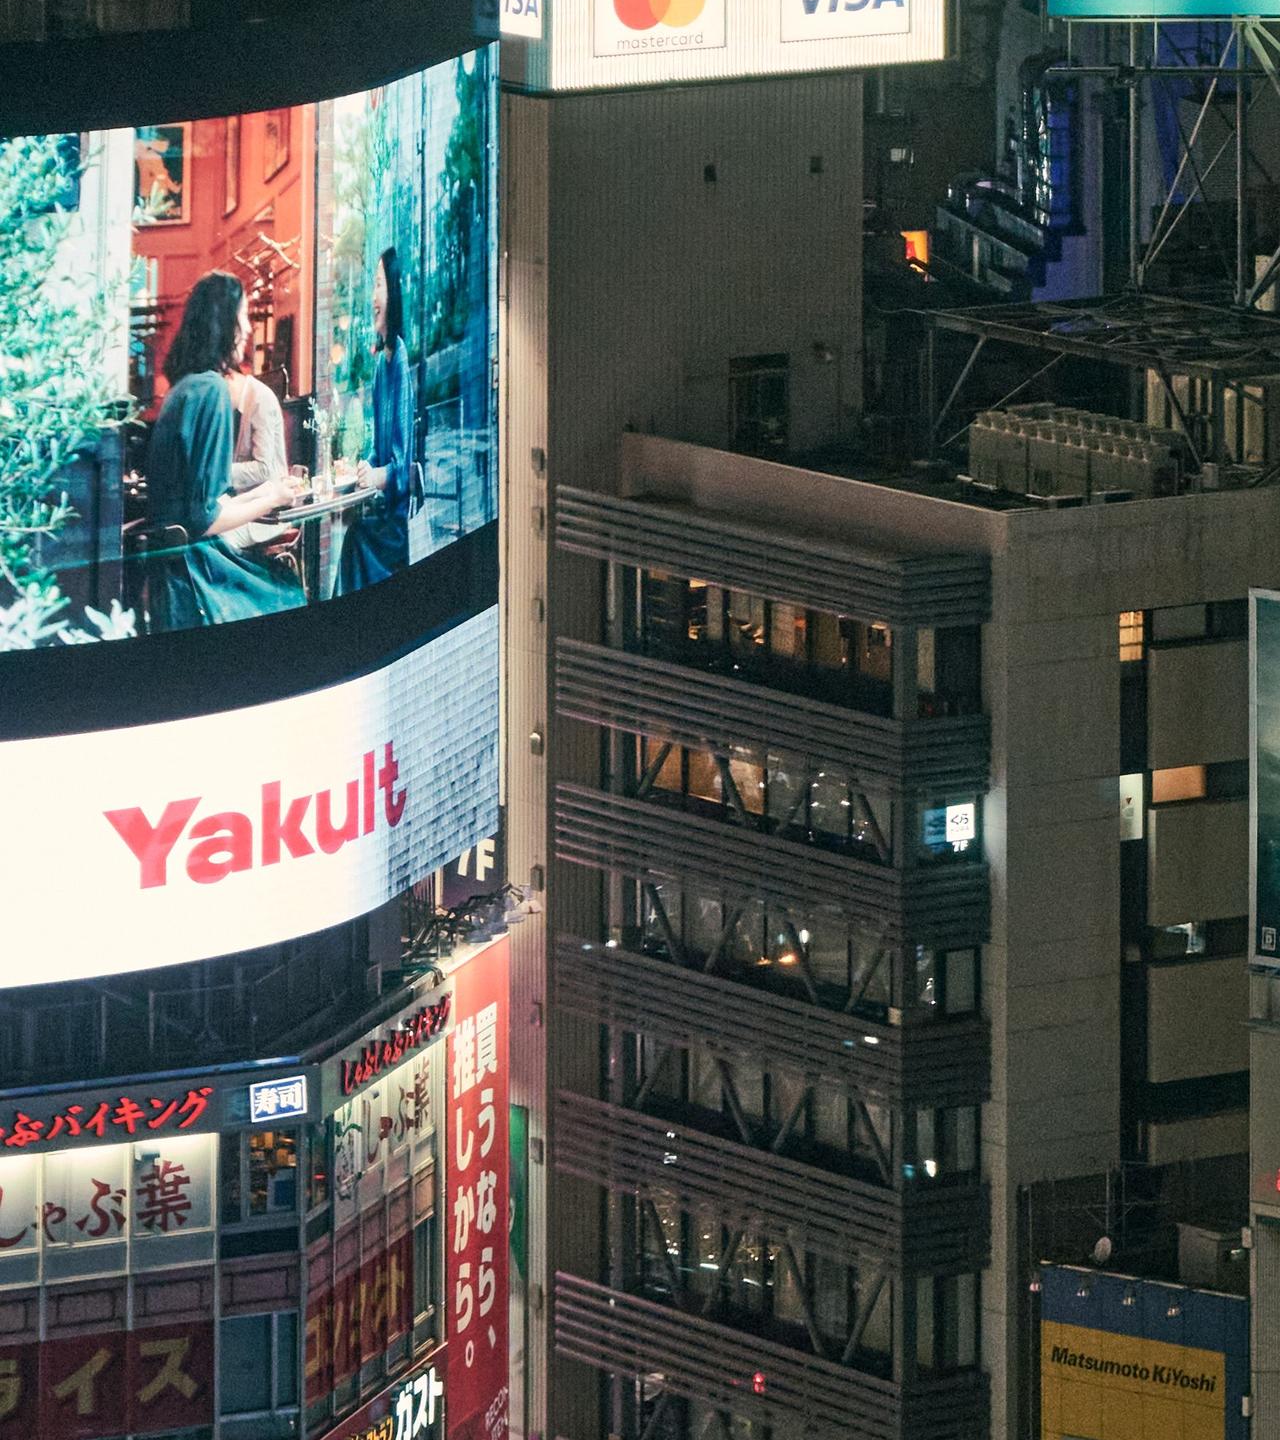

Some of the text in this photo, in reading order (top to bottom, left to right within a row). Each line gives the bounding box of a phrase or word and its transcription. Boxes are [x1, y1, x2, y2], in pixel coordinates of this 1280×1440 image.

[616, 31, 704, 51] mastercard
[103, 740, 407, 890] Yakult
[0, 1087, 213, 1148] ぶバイキング
[255, 1084, 302, 1117] 寿司
[453, 1016, 476, 1368] 推しから。
[476, 1001, 498, 1350] 買うなら、
[1050, 1344, 1217, 1394] Matsumoto KiYoshi
